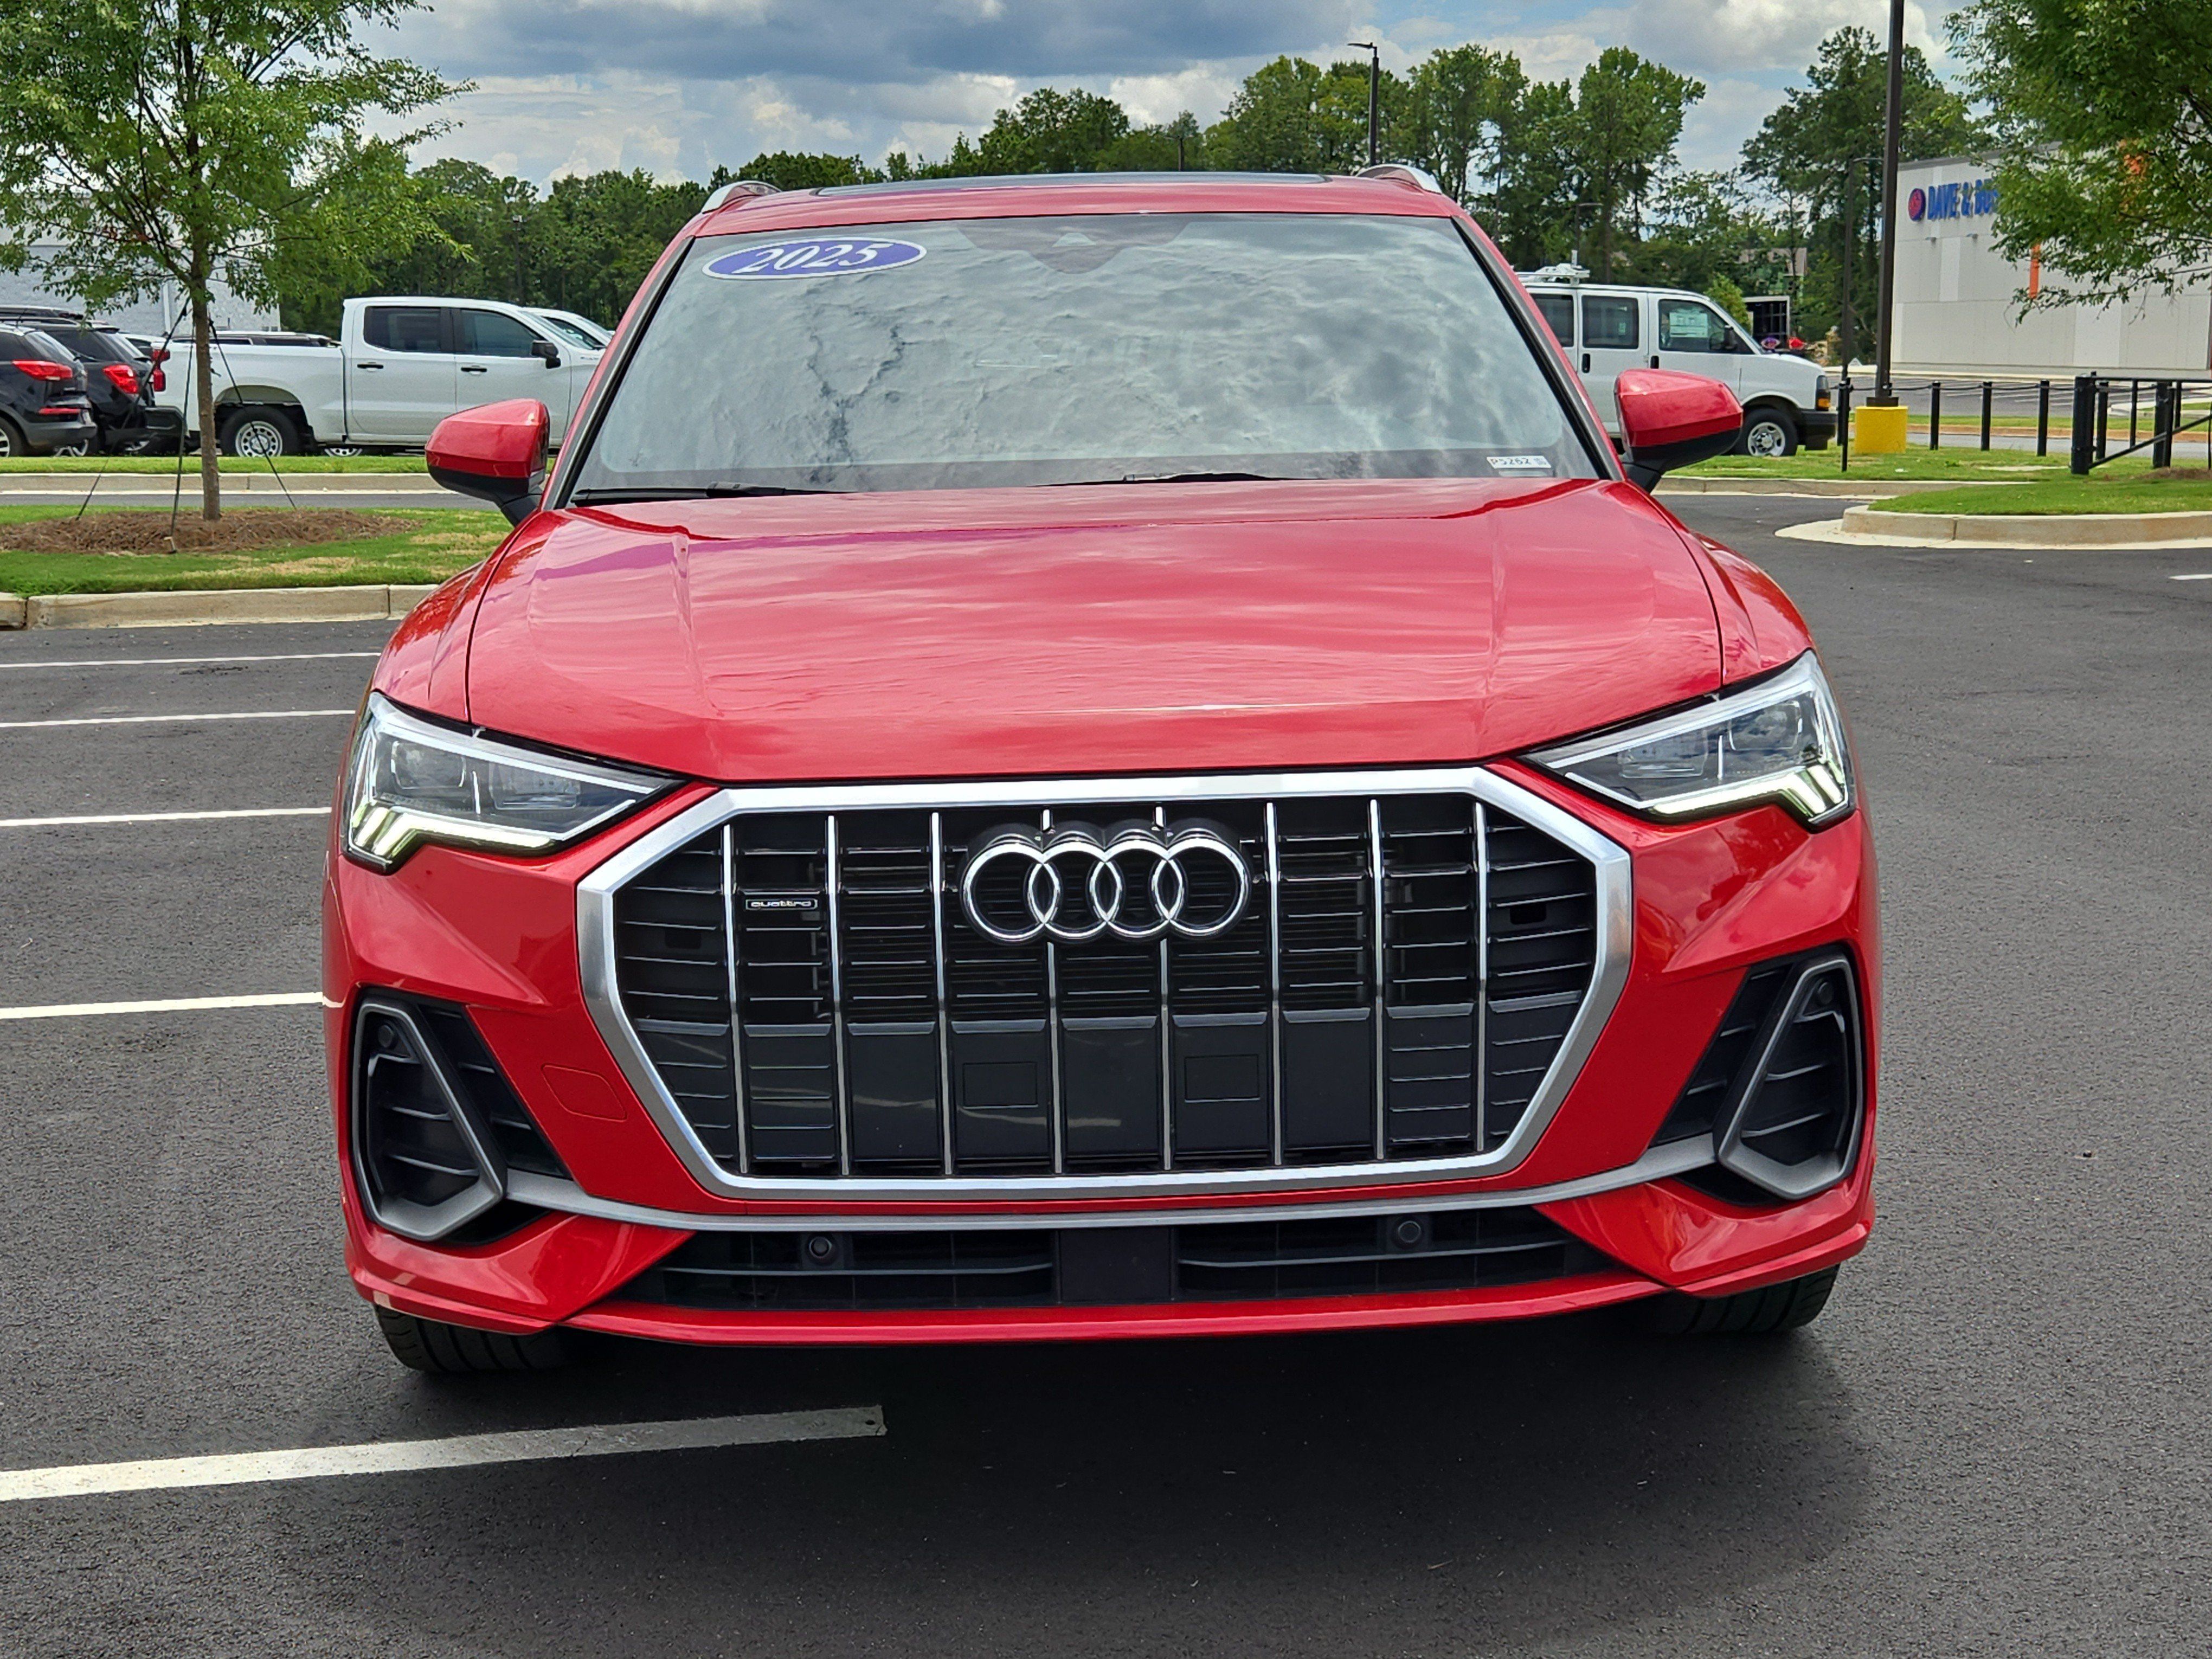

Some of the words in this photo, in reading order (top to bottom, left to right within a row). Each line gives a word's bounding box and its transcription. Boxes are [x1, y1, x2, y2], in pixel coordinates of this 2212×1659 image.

[1927, 183, 1959, 220] DAVE
[1961, 182, 1970, 216] &
[731, 243, 894, 273] 2025
